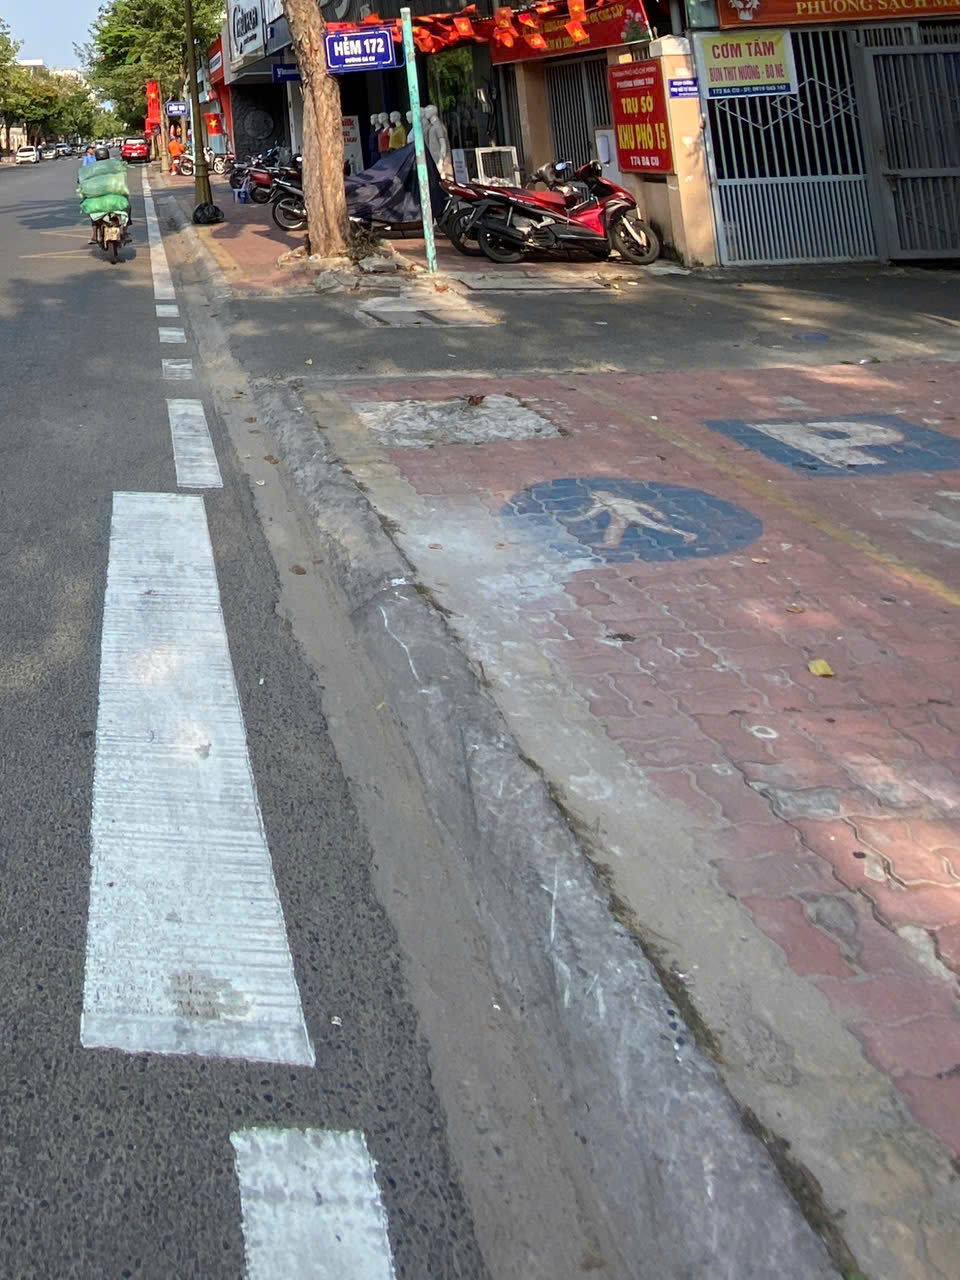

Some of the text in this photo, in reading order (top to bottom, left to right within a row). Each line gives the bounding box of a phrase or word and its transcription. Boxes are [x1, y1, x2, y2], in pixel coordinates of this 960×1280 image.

[333, 36, 385, 57] HẺM 172
[711, 36, 775, 59] CƠM TẤM
[621, 90, 654, 118] TRỤ SỞ
[617, 113, 667, 150] KHU PHỐ 15
